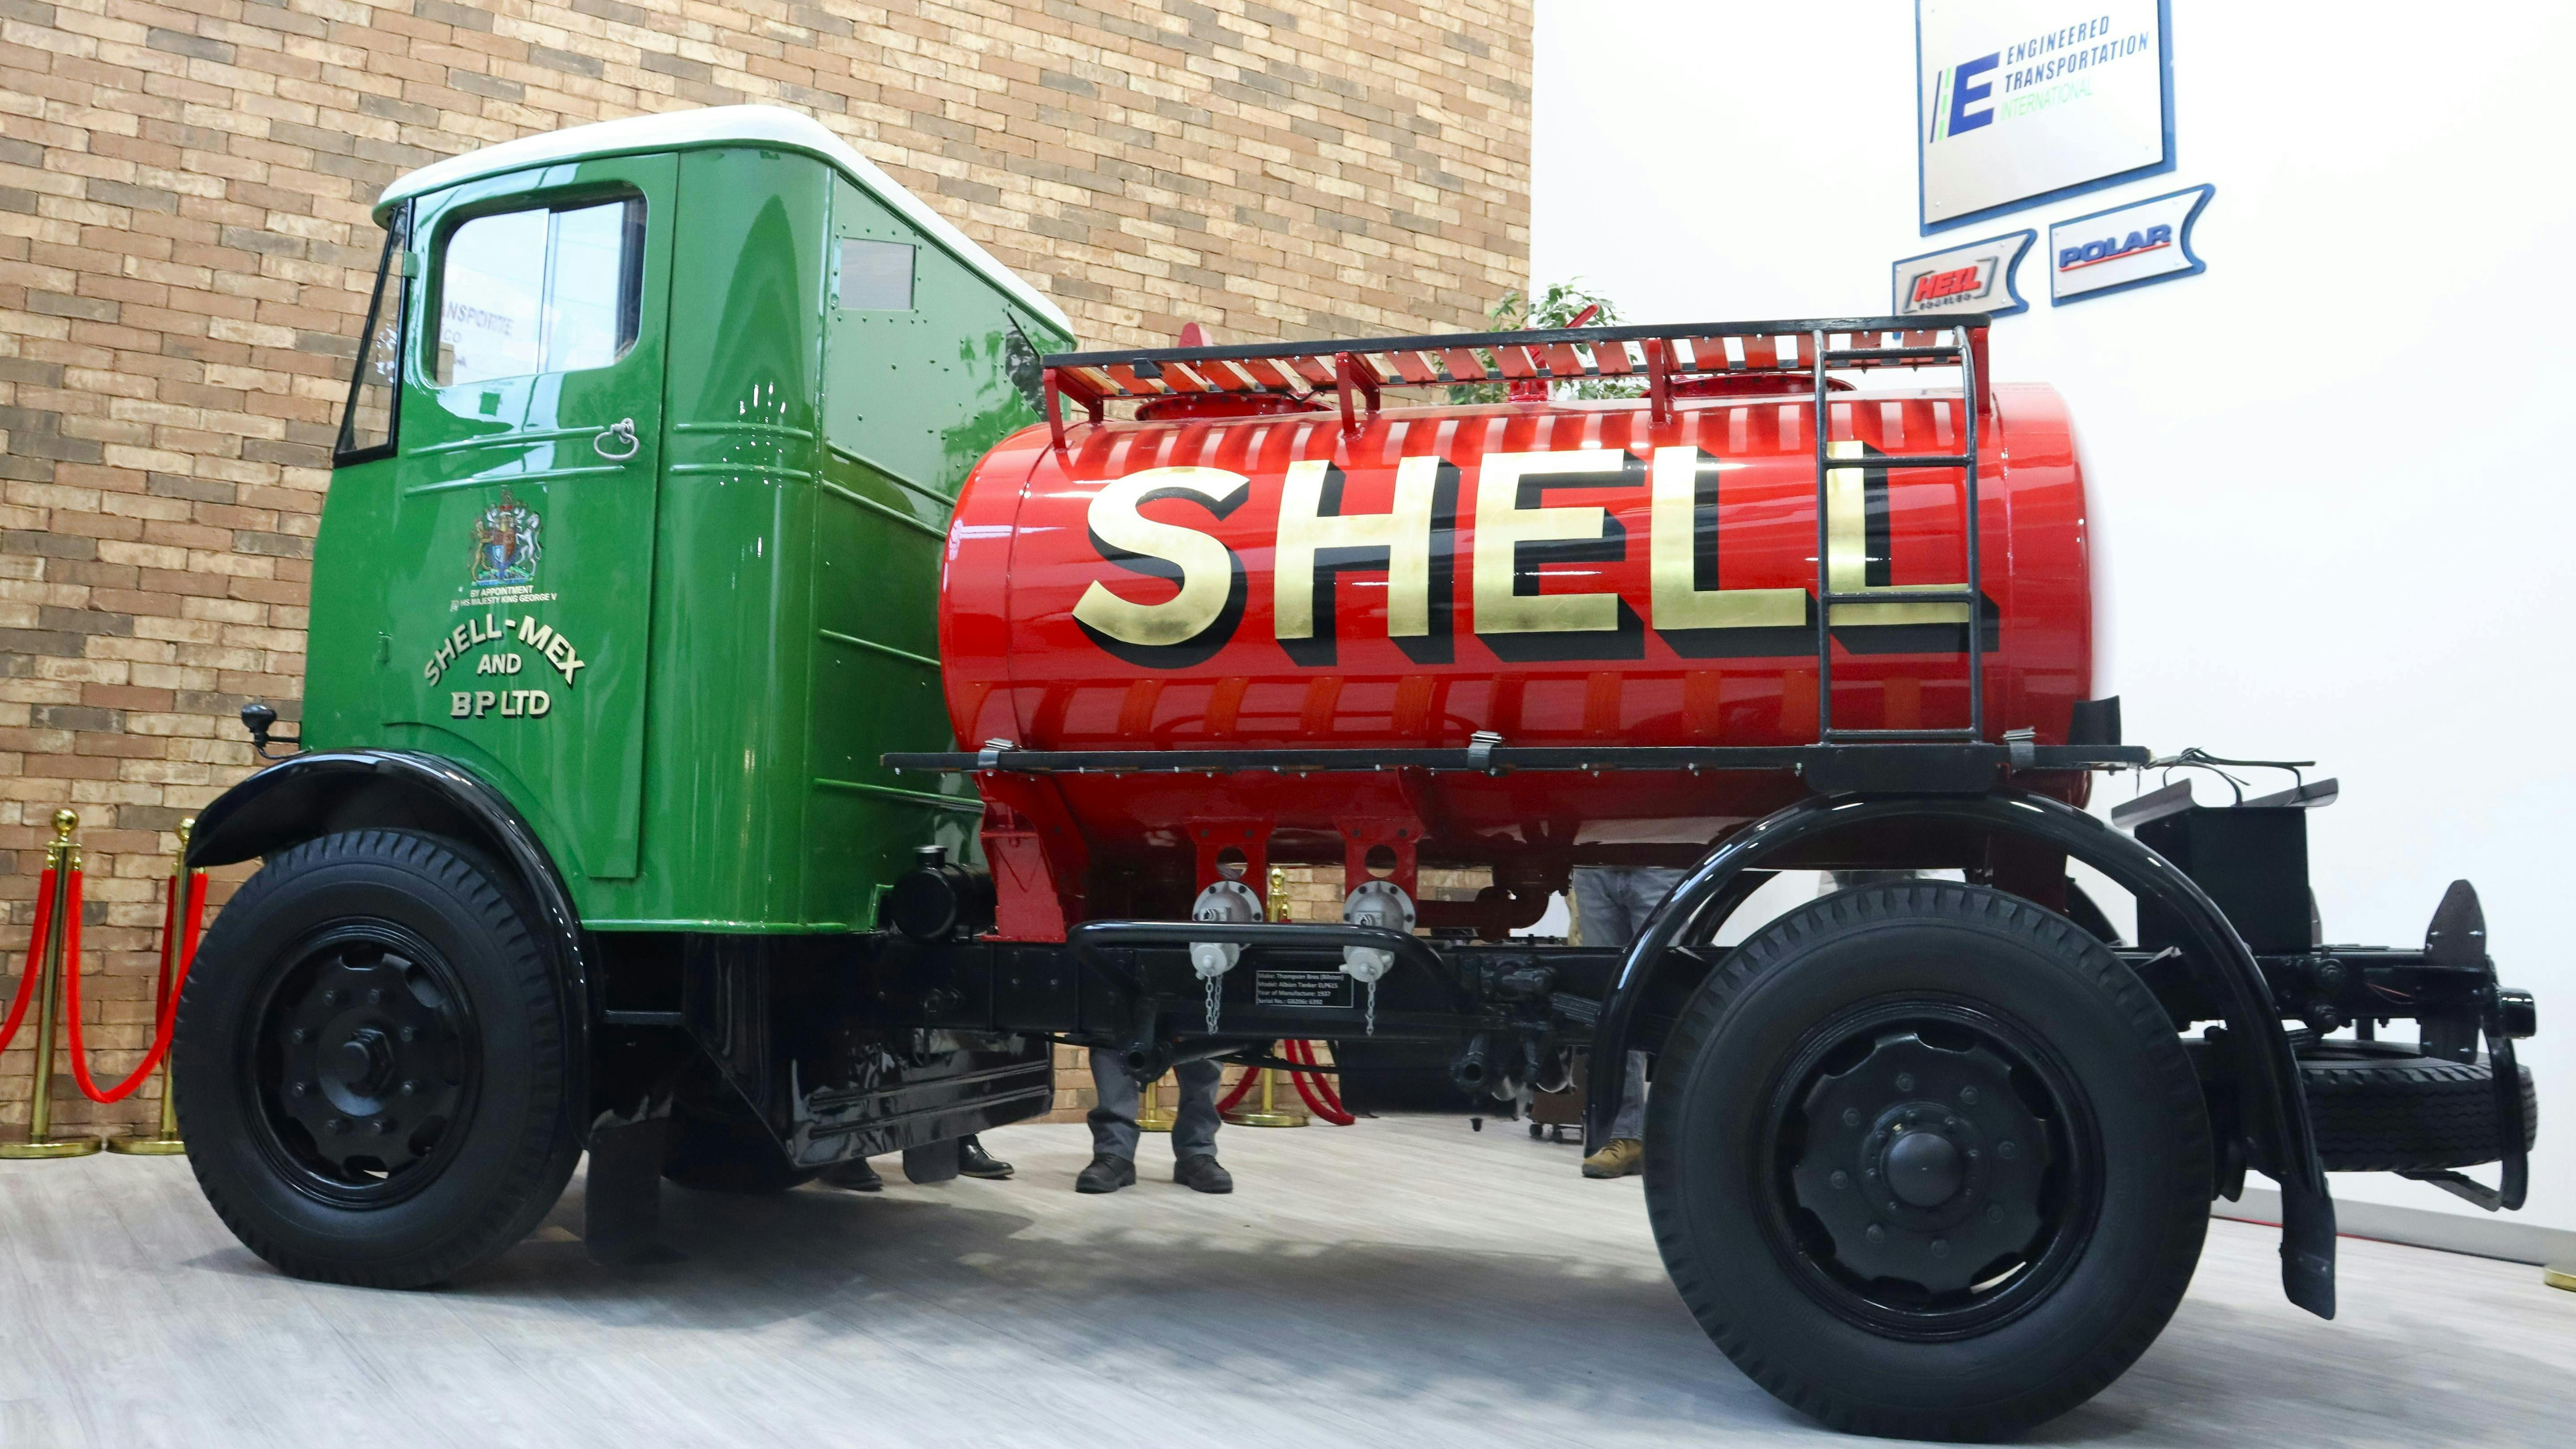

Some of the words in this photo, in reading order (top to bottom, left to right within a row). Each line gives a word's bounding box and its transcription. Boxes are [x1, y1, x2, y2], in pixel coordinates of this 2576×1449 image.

[2007, 16, 2110, 65] ENGINEERED
[2005, 32, 2149, 93] TRANSPORTATION
[2000, 77, 2093, 122] INTERNATIONAL
[2058, 223, 2172, 268] POLAR
[1914, 265, 1982, 302] HEIL
[441, 300, 514, 336] NSPORTE
[1072, 440, 1971, 646] SHELL
[470, 589, 480, 598] BY
[481, 585, 534, 597] APPOINTMENT
[471, 596, 500, 605] MAJESTY
[501, 595, 519, 603] KING
[519, 593, 550, 602] GEORGE
[551, 593, 558, 601] V
[424, 613, 586, 687] SHELL-MEX
[476, 653, 523, 674] AND
[451, 691, 496, 717] BP
[500, 690, 551, 716] LTD
